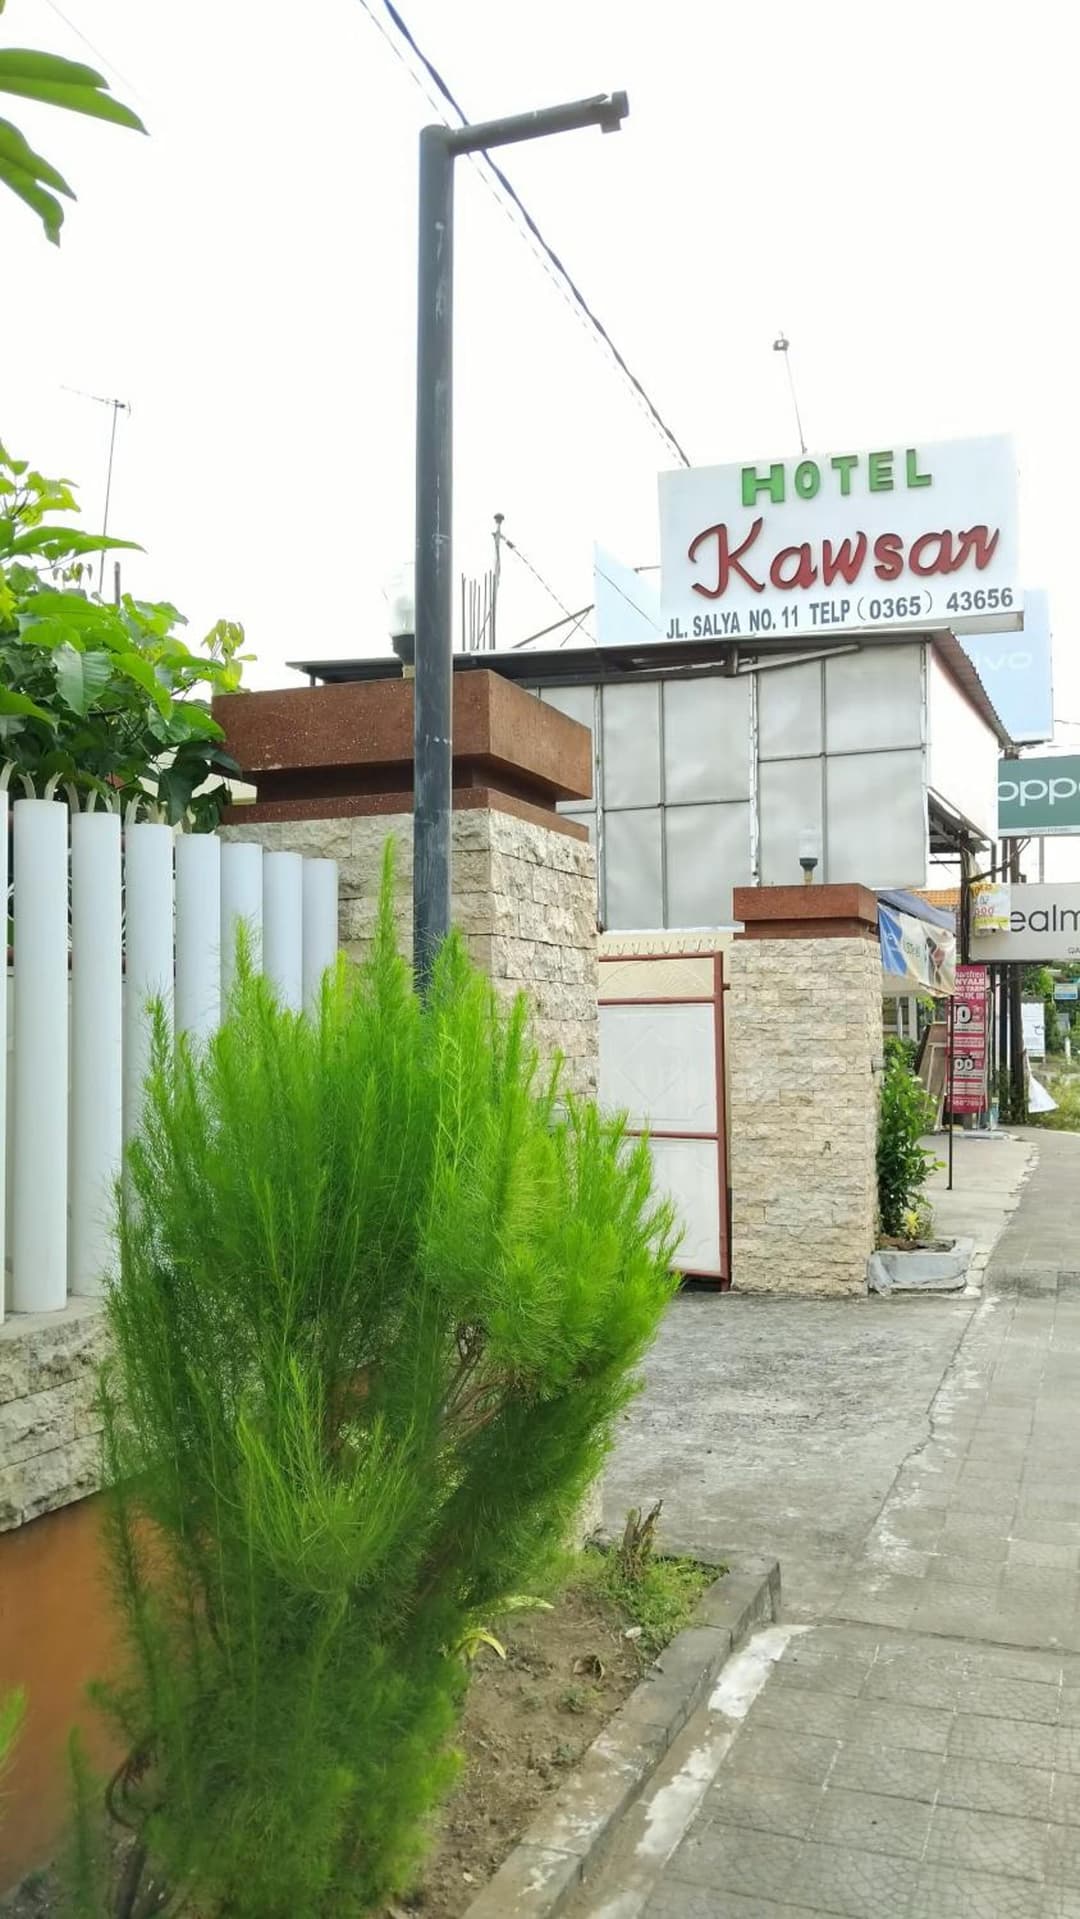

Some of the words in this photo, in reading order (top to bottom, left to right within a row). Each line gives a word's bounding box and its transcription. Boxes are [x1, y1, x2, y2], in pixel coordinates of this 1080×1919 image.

[741, 448, 932, 507] HOTEL
[687, 516, 1000, 599] Kawsar
[666, 618, 688, 639] JL.
[692, 611, 741, 637] SALYA
[749, 608, 776, 632] NO.
[781, 605, 798, 629] 11
[809, 599, 850, 625] TELP
[857, 589, 933, 621] (0365)
[946, 587, 1013, 612] 43656
[997, 777, 1080, 807] opp
[1010, 903, 1080, 933] ealm
